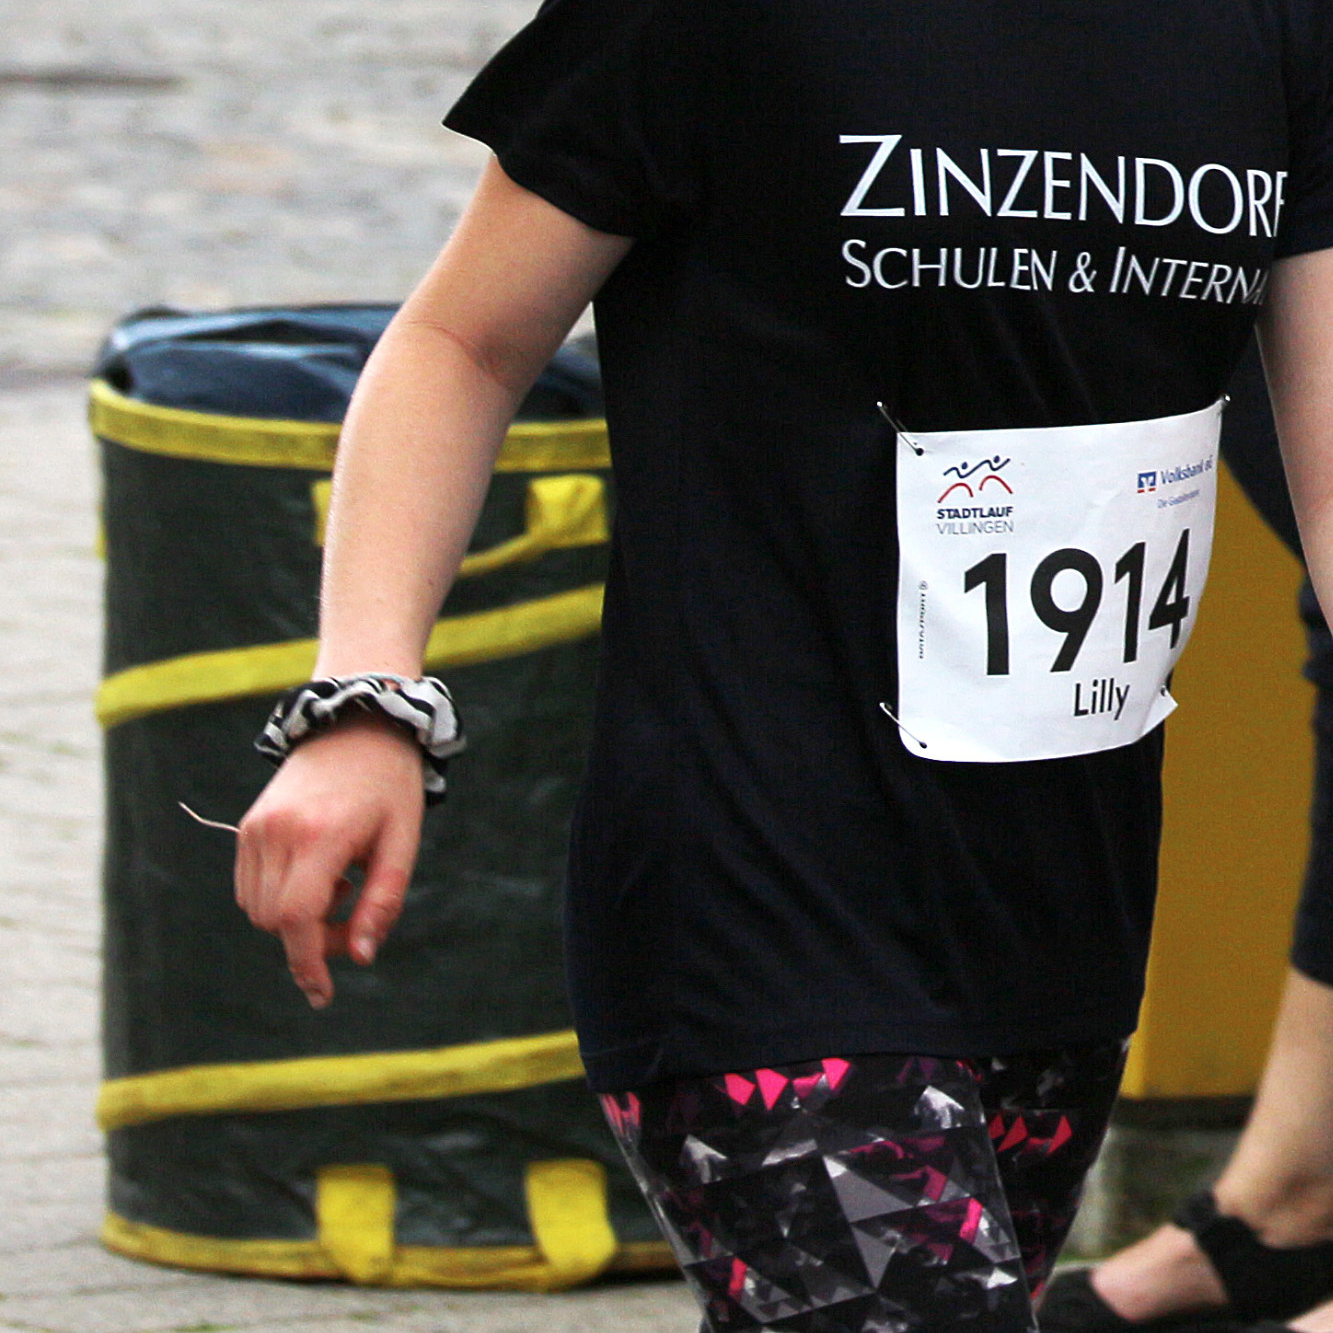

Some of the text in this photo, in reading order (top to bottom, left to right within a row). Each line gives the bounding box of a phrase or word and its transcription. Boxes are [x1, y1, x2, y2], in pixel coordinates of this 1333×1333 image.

[839, 134, 1288, 238] ZINZENDORF
[841, 239, 1057, 291] SCHULEN
[1069, 251, 1097, 293] &
[936, 520, 1014, 535] VILLINGEN
[937, 506, 1014, 520] STADTLAUF
[964, 528, 1190, 676] 1914
[1073, 678, 1130, 721] Lilly
